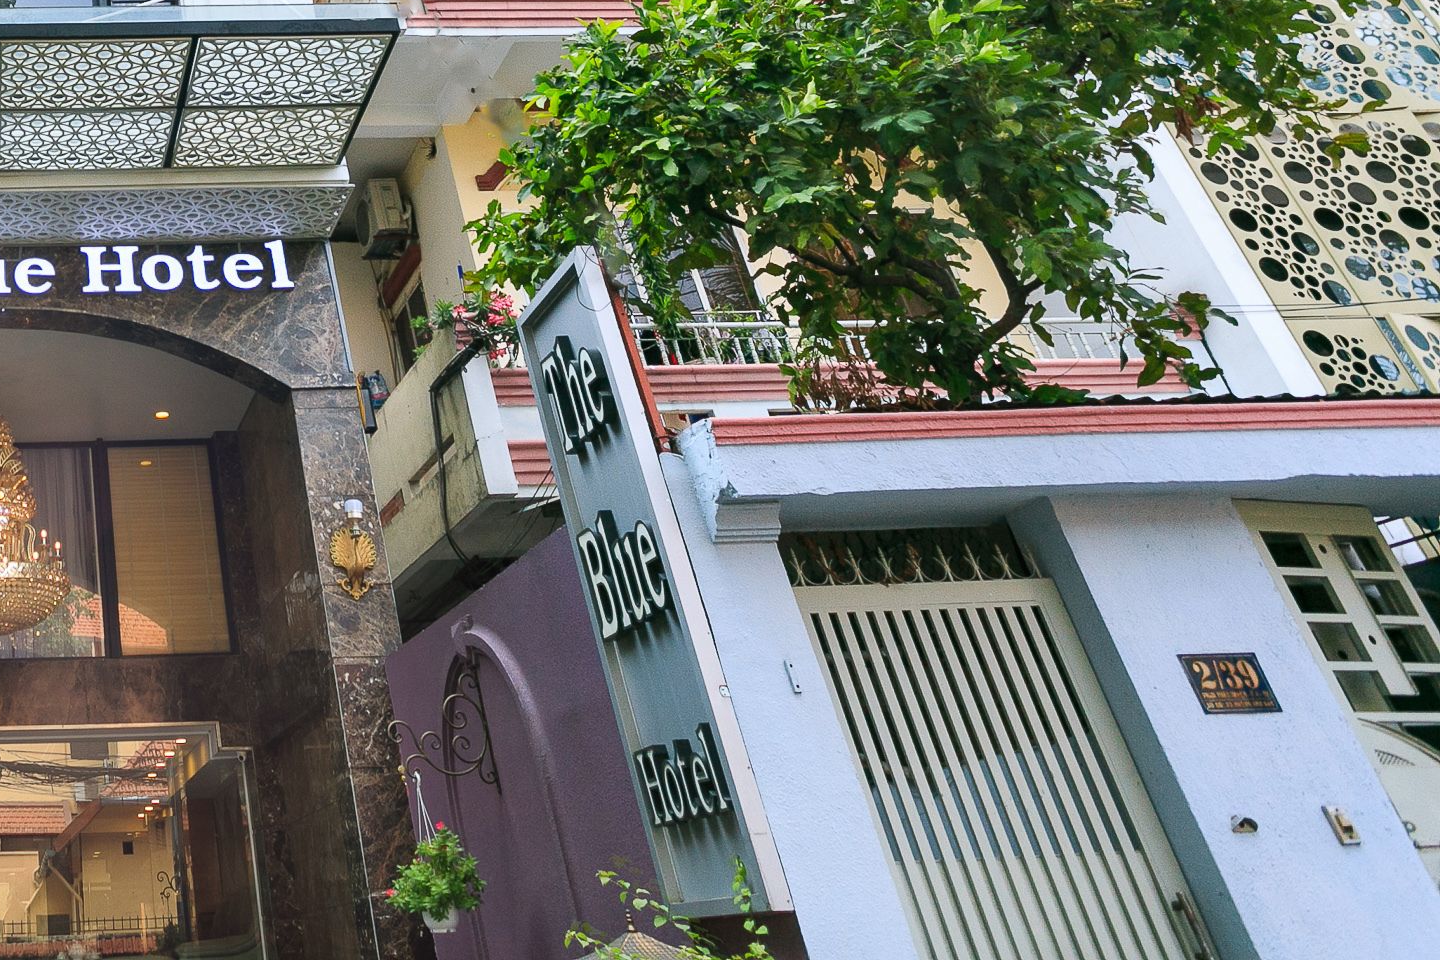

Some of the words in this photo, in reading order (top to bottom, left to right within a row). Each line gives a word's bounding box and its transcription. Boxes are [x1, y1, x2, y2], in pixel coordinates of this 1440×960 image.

[79, 239, 296, 295] Hotel
[541, 343, 606, 452] The
[577, 516, 666, 640] Blue
[1192, 659, 1259, 690] 2/39
[636, 729, 728, 825] Hotel
